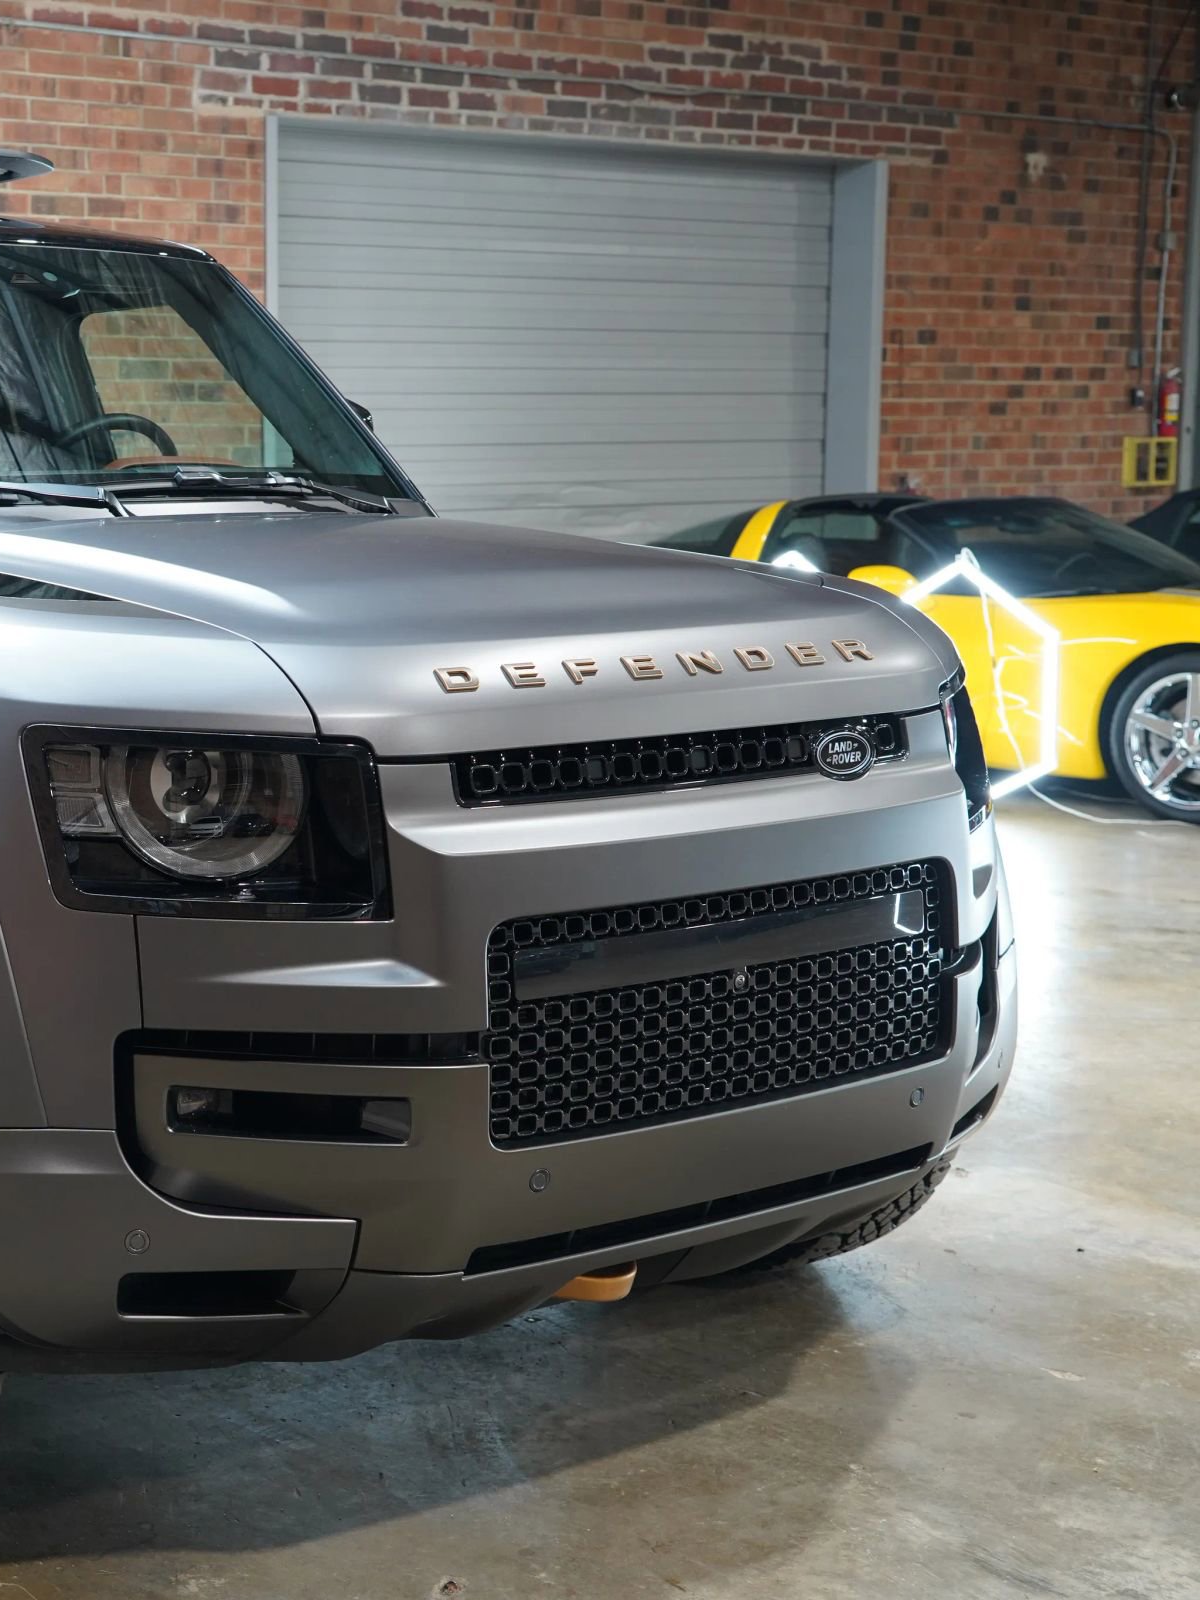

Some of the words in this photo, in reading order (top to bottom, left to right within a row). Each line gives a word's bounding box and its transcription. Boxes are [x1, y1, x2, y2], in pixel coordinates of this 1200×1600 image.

[433, 638, 875, 693] DEFENDER
[828, 740, 853, 754] LAND
[832, 751, 862, 765] ROVER
